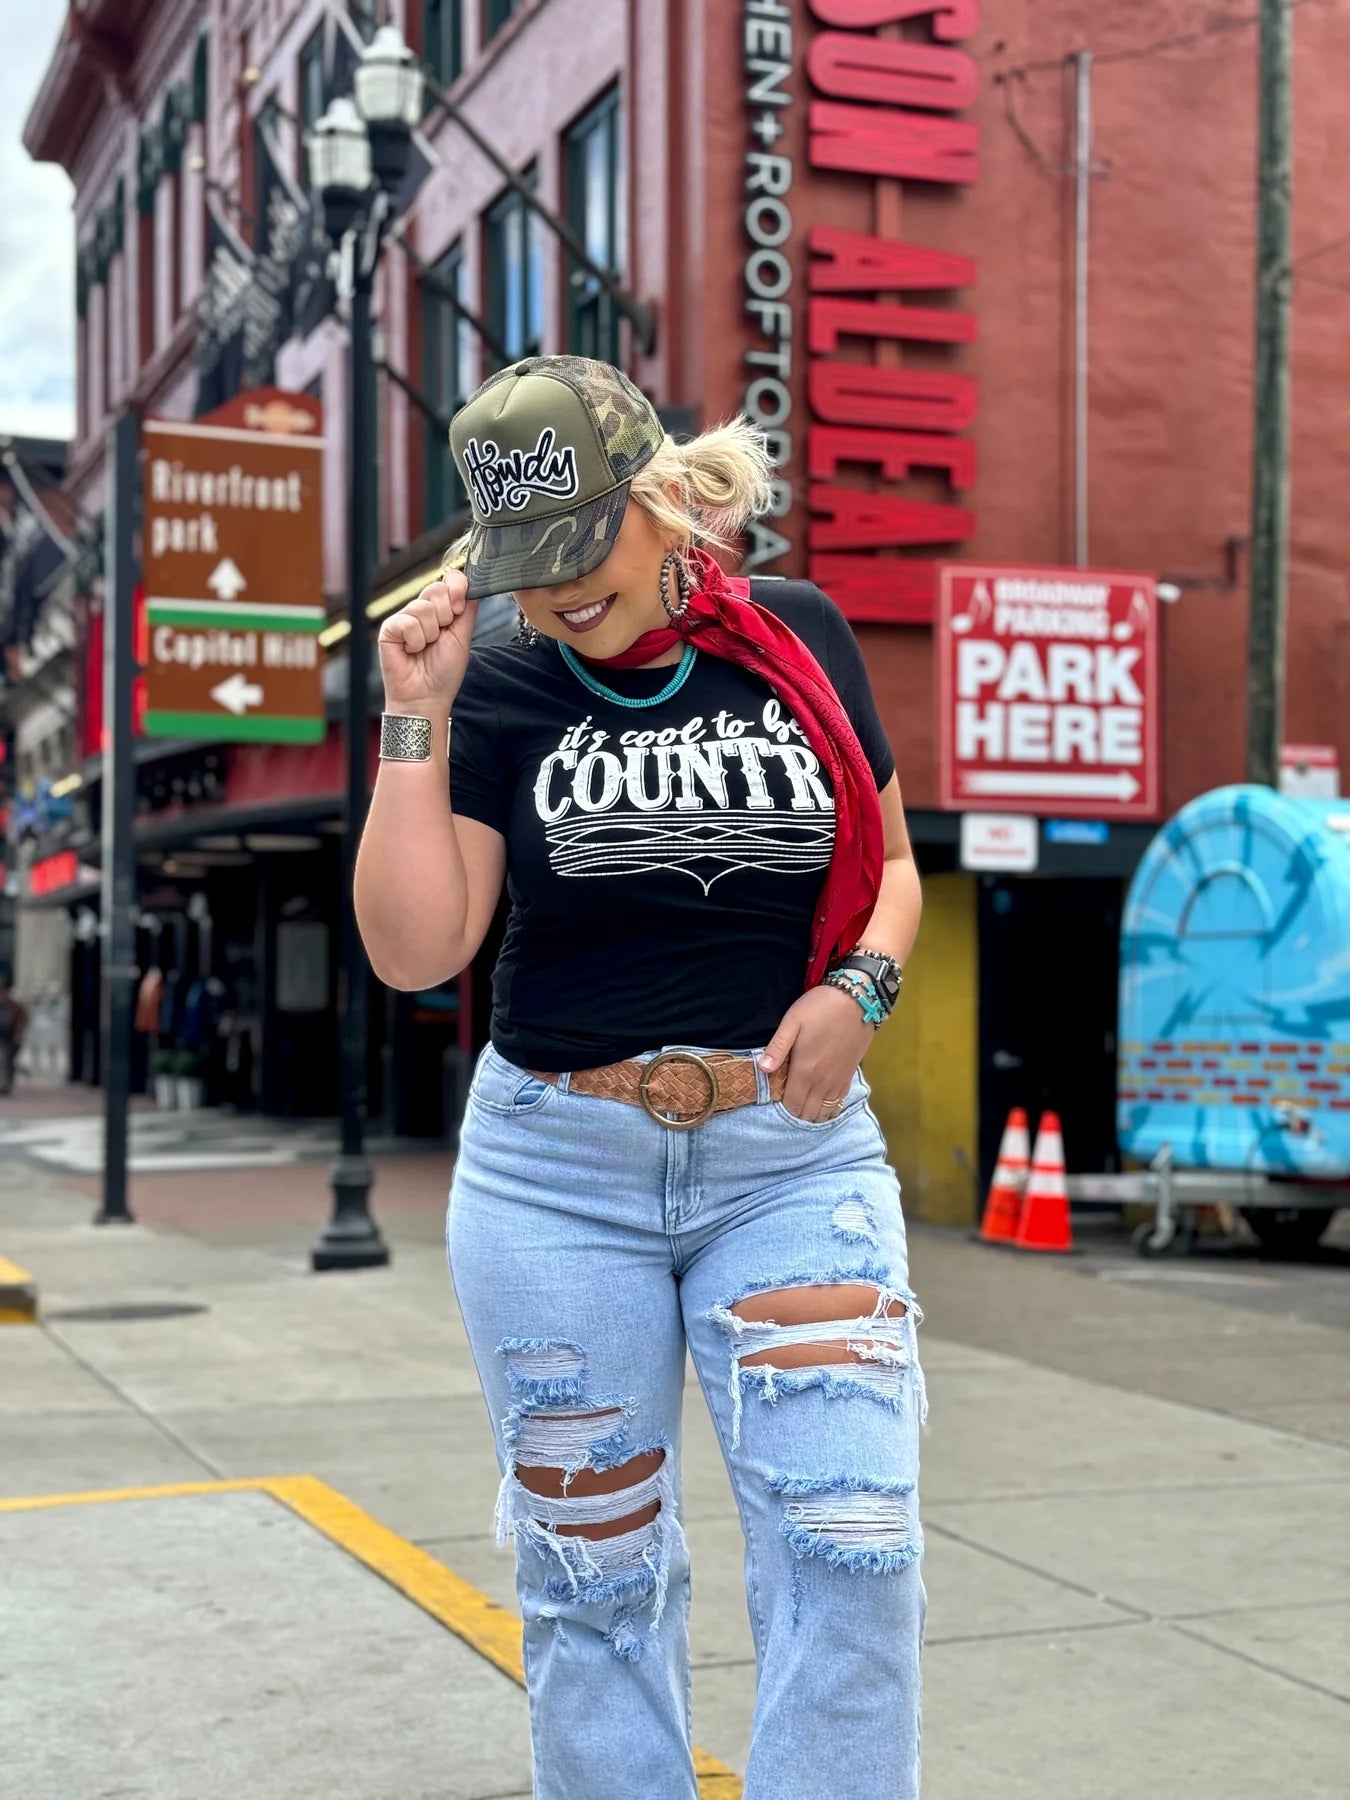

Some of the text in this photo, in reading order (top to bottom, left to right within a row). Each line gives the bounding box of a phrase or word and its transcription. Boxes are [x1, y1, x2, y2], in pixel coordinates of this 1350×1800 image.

[152, 459, 302, 513] Riverfront
[463, 427, 579, 518] Howdy
[739, 480, 792, 580] BA
[263, 632, 317, 670] Hill
[993, 604, 1110, 640] PARKING
[957, 639, 1144, 706] PARK
[558, 716, 611, 752] it's
[620, 717, 706, 747] cool
[711, 710, 756, 738] to
[955, 701, 1144, 766] HERE
[533, 737, 836, 823] COUNTR
